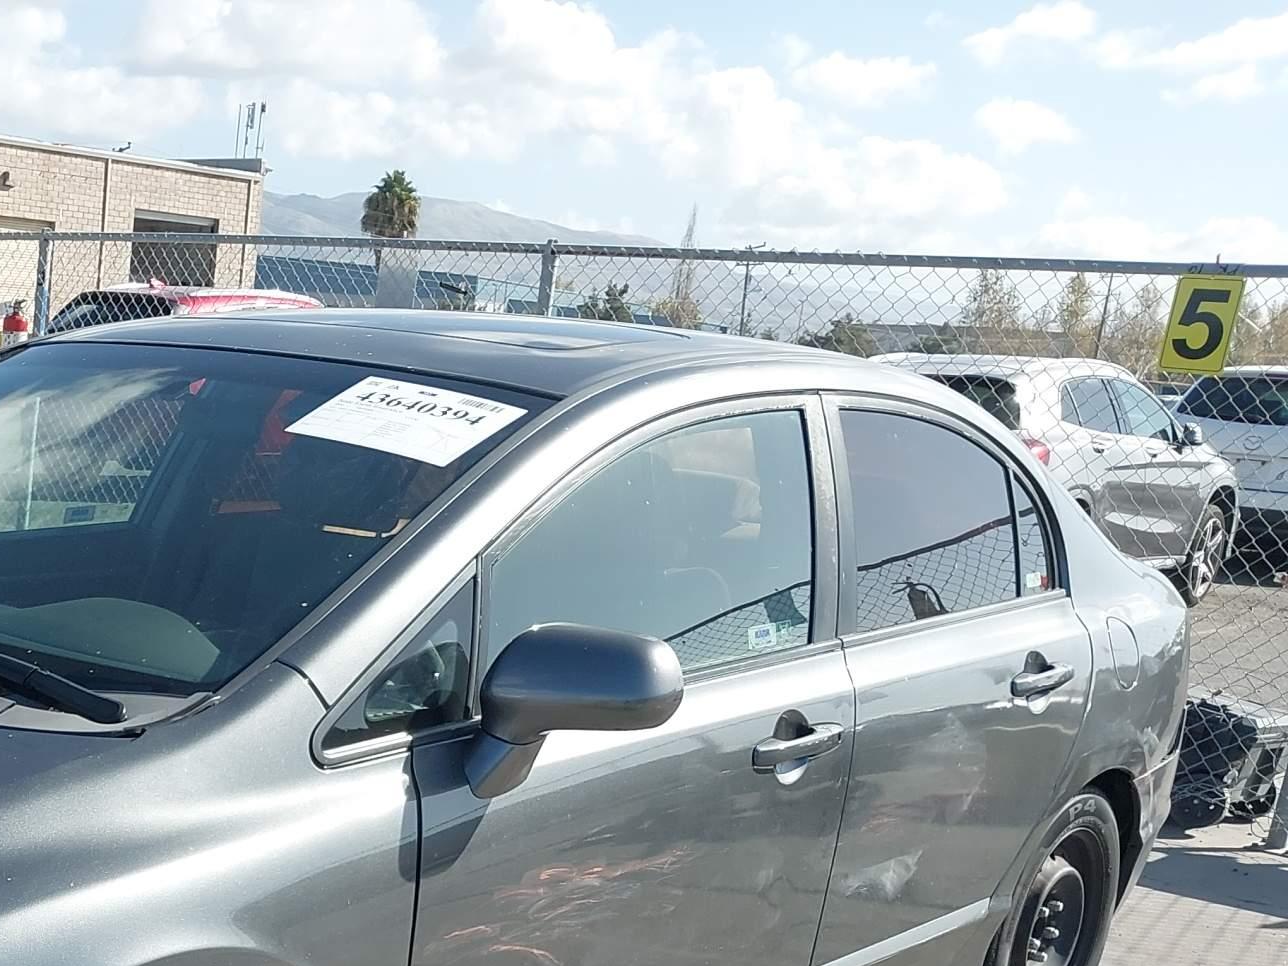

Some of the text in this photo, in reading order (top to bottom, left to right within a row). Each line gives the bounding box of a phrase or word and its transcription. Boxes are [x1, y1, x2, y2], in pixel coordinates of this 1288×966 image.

[1172, 288, 1231, 360] 5
[356, 391, 487, 425] 43640394
[1069, 799, 1096, 821] P4
